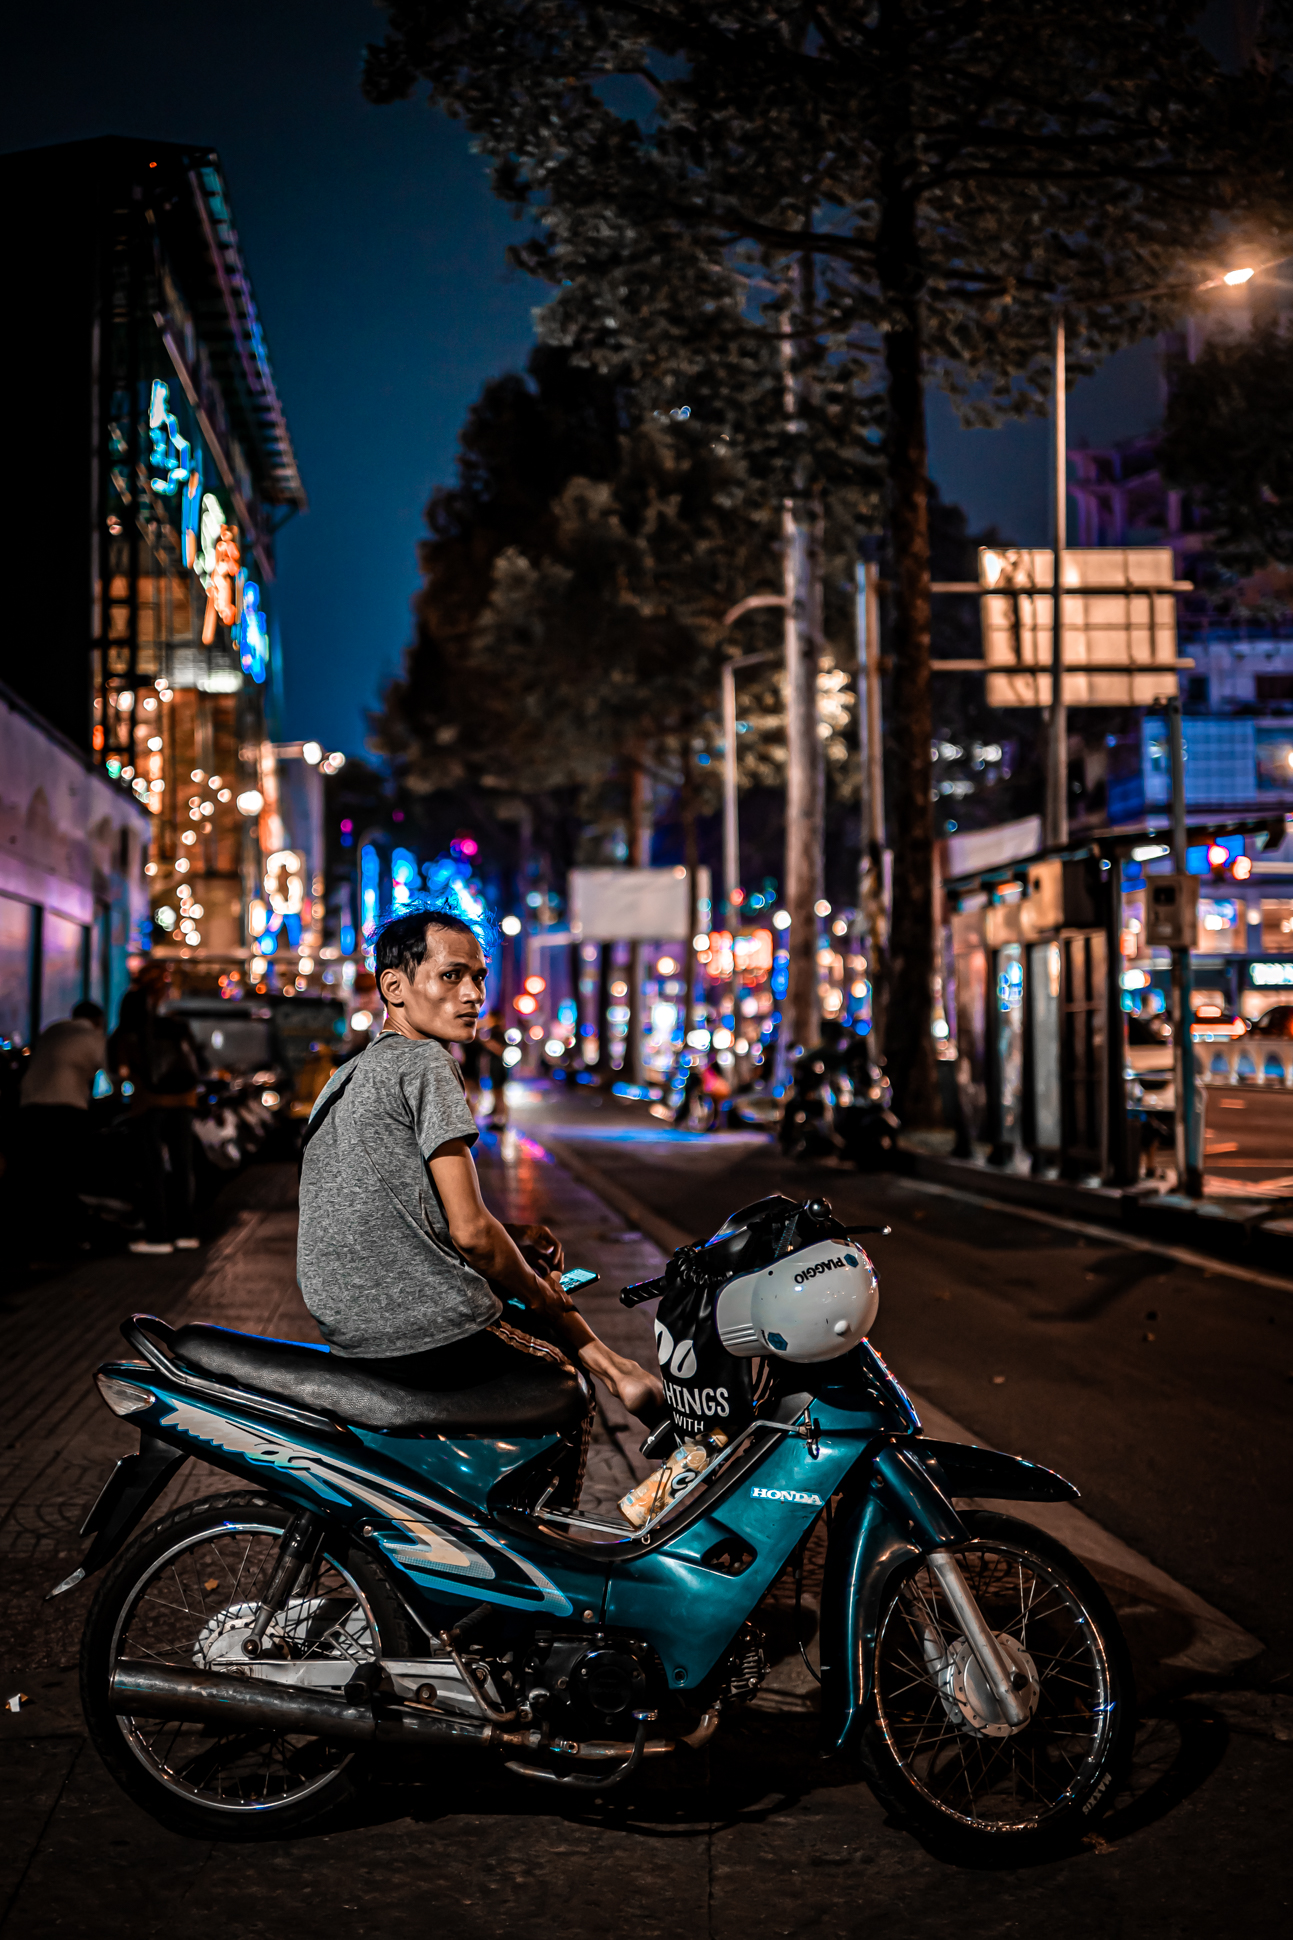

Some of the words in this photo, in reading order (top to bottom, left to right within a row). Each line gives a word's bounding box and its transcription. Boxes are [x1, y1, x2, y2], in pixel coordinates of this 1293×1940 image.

[795, 1257, 846, 1284] PIAGGIO
[673, 1410, 705, 1433] WITH
[752, 1487, 823, 1506] HONDA
[1081, 1771, 1113, 1816] MAXXIS
